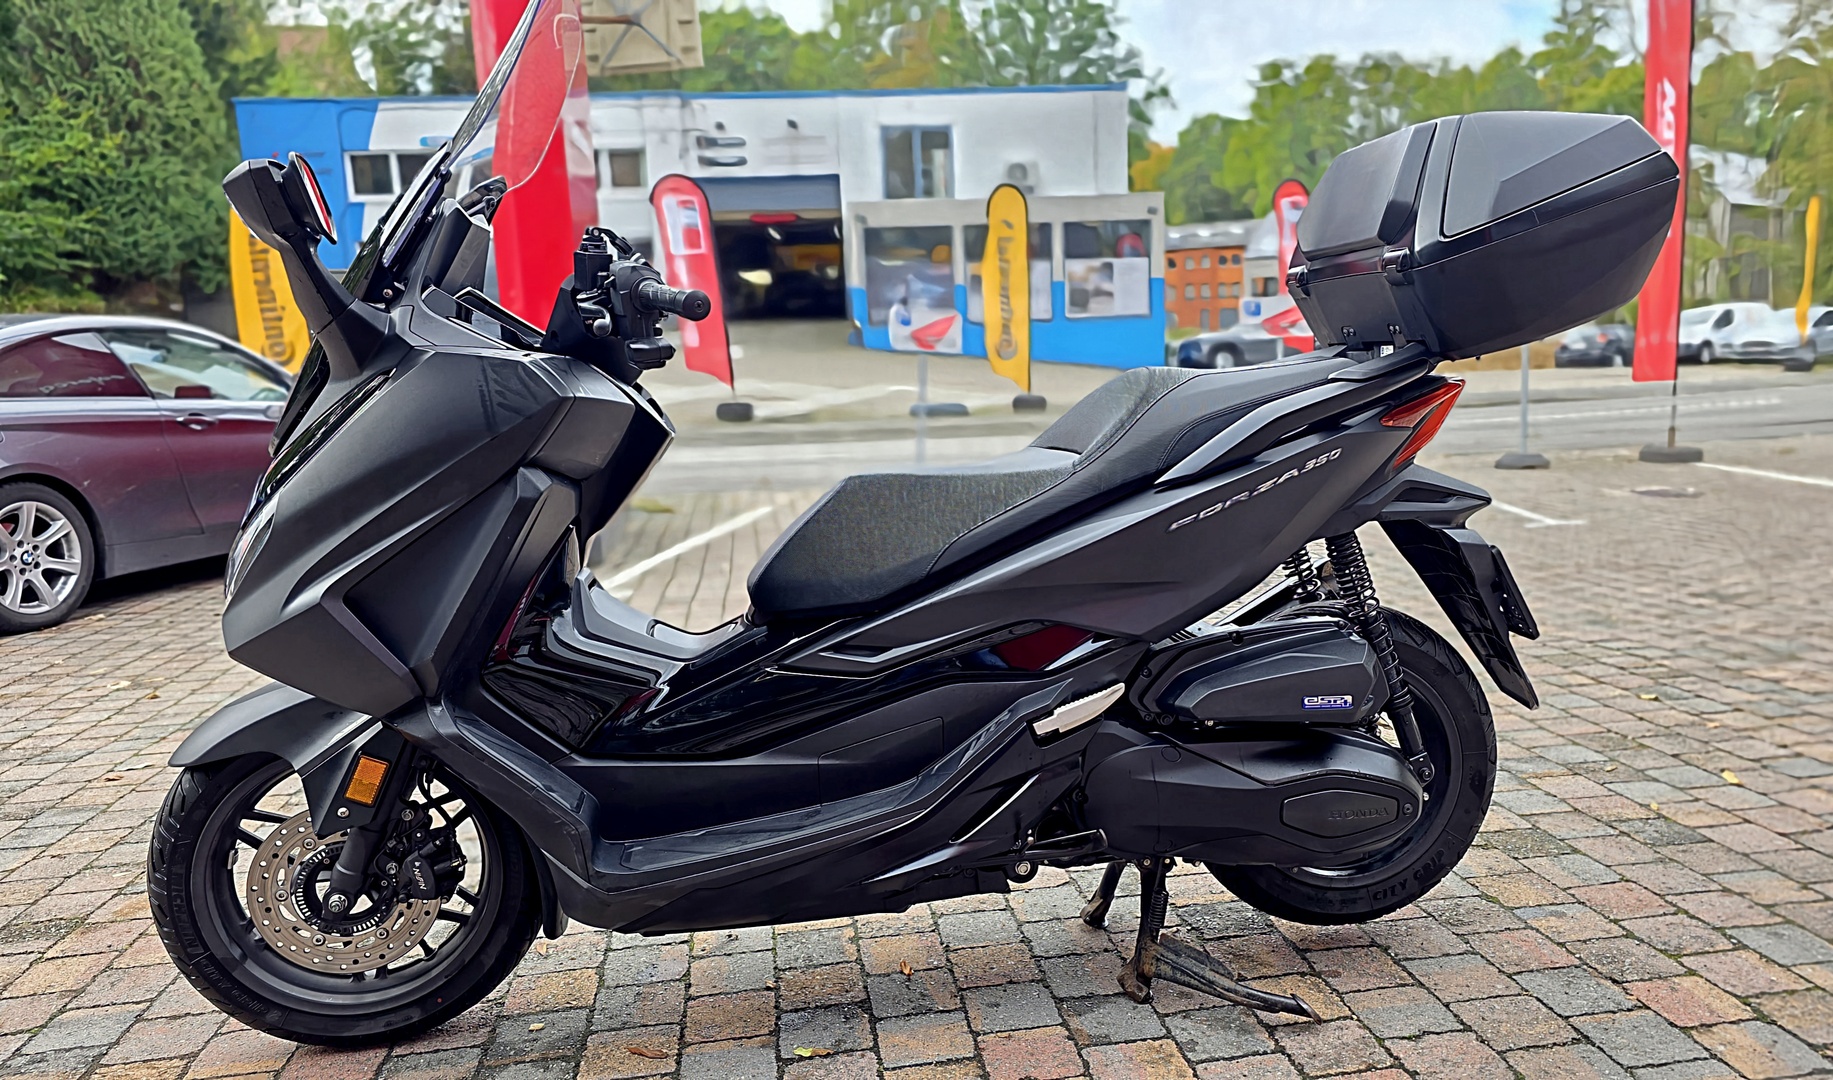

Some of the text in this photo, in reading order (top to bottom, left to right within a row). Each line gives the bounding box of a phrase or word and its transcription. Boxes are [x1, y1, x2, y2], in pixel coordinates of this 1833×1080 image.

[1166, 447, 1343, 532] FORZA 350
[1327, 806, 1390, 821] HONDA
[1372, 878, 1408, 901] CITY
